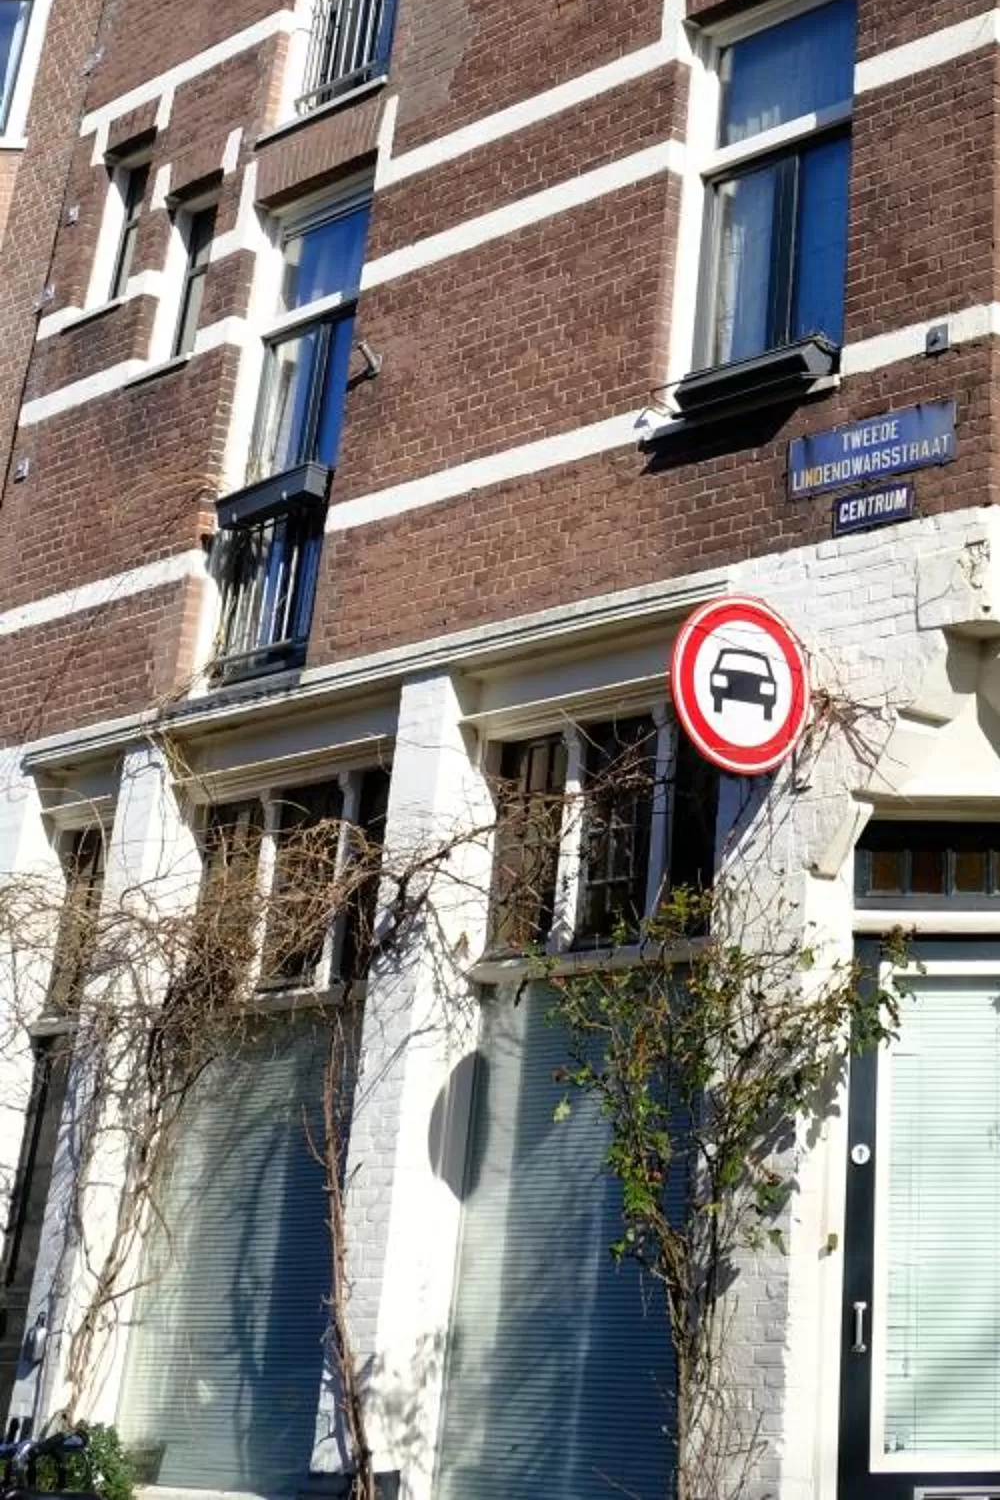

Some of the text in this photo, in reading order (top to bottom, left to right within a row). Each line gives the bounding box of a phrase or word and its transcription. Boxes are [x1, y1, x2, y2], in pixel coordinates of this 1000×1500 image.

[842, 419, 900, 452] TWEEDE
[792, 433, 952, 491] LINDENDWARSSTRAAT
[839, 488, 908, 523] CENTRUM
